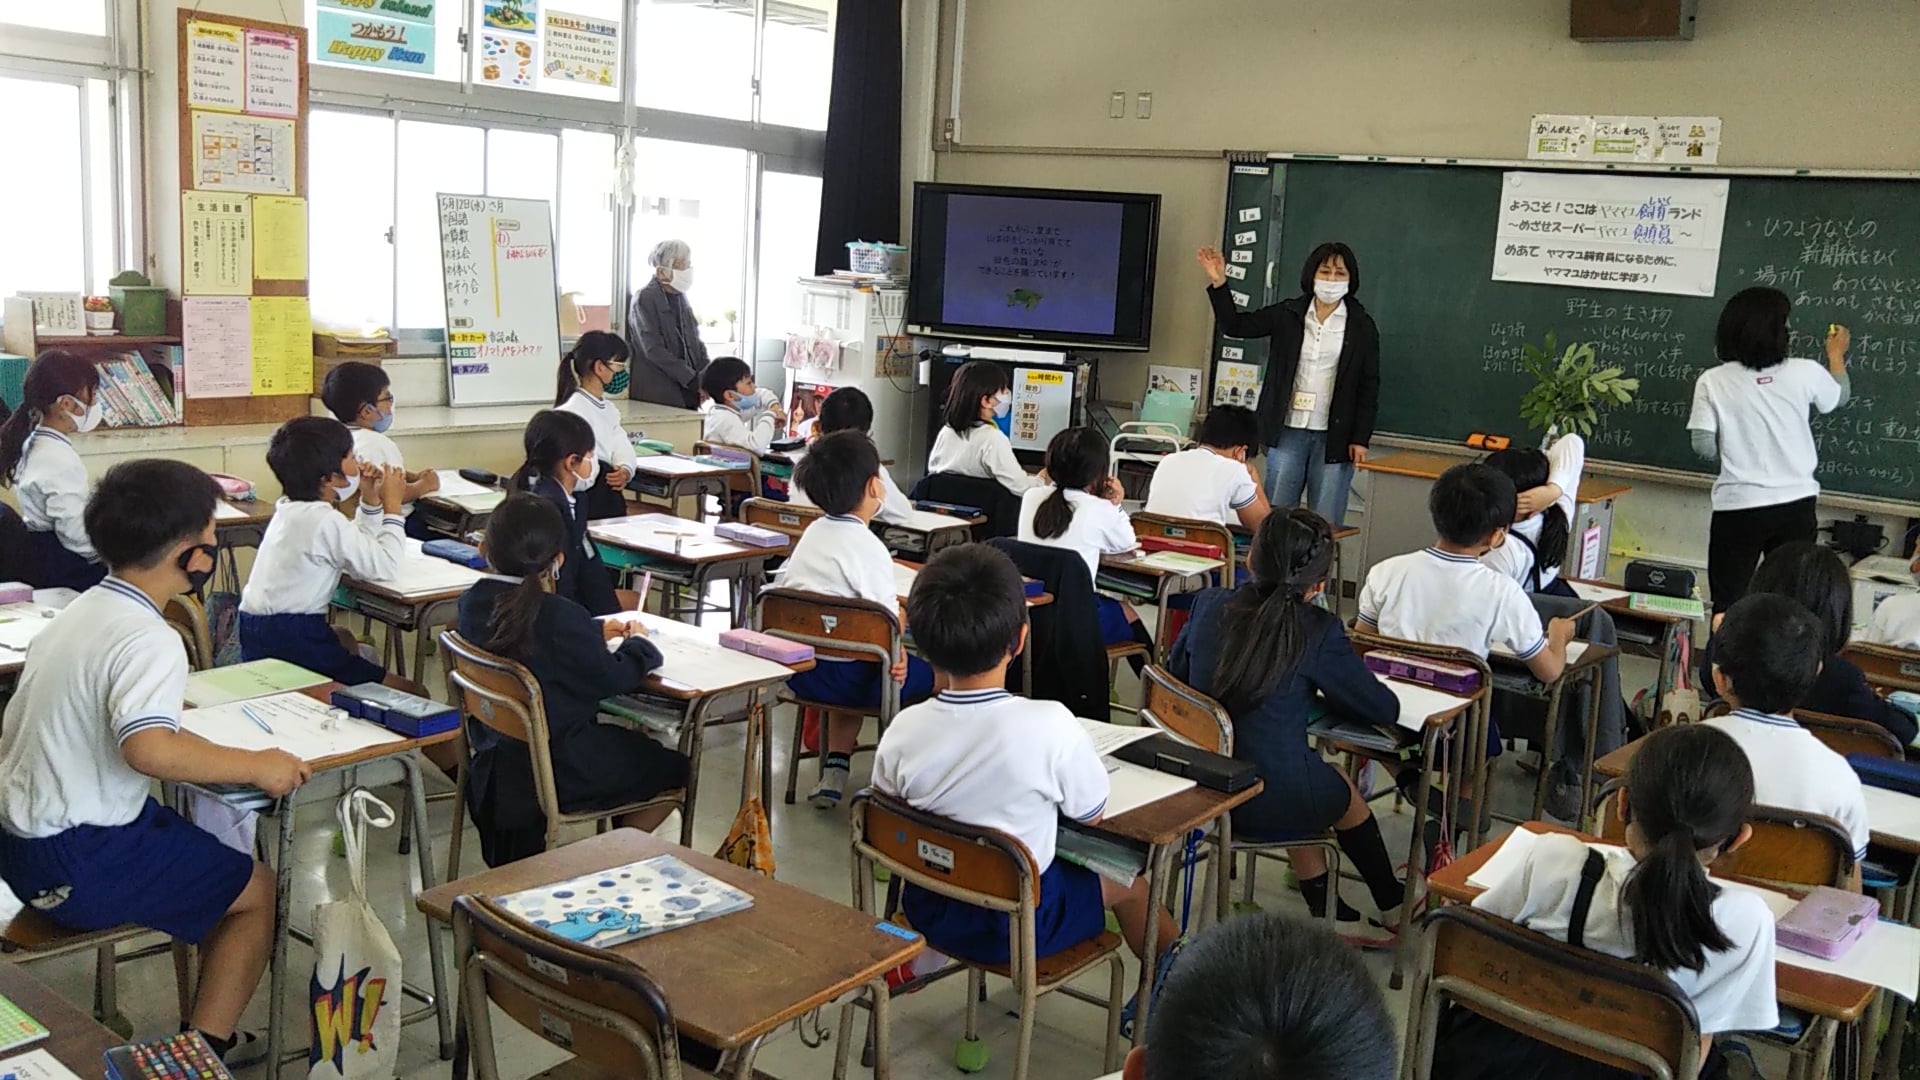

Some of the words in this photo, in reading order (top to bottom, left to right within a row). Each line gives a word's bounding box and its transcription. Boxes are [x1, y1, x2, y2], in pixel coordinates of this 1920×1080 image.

[328, 40, 385, 61] Happy
[1764, 216, 1877, 239] ひつようなもの
[1504, 244, 1540, 257] めあて
[1753, 265, 1804, 288] 場所
[1566, 297, 1673, 328] 野生の生き物
